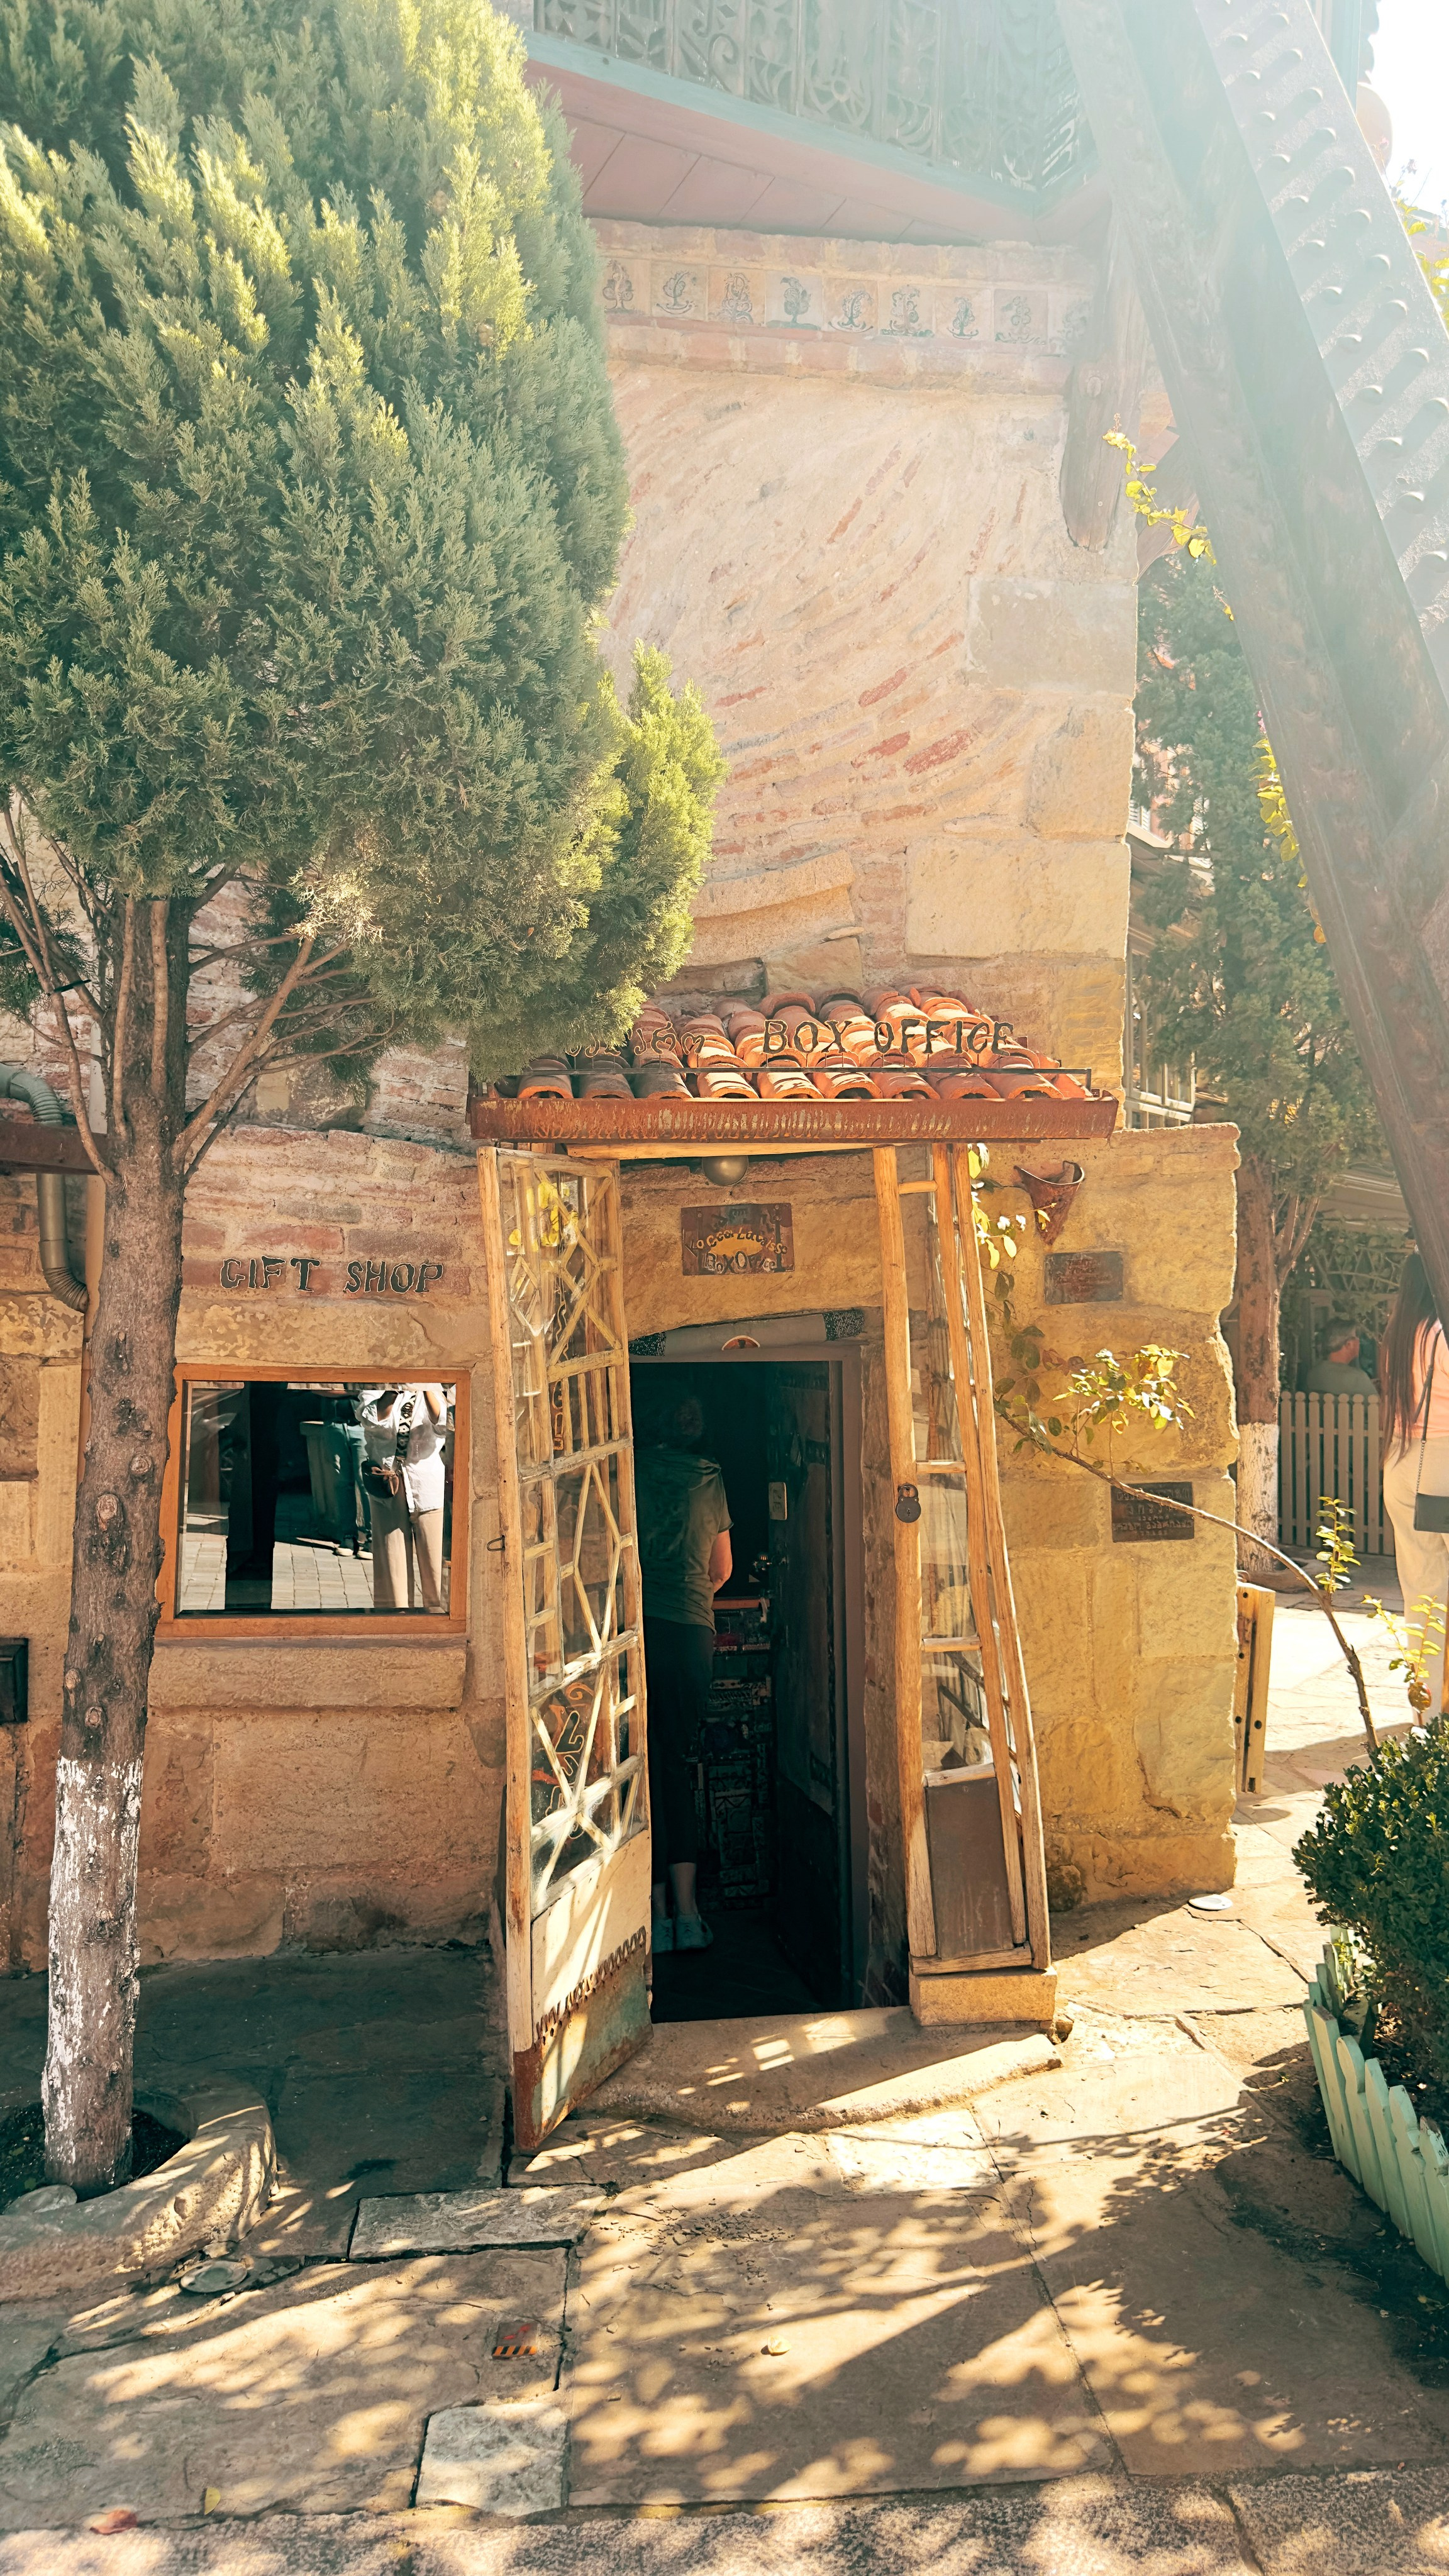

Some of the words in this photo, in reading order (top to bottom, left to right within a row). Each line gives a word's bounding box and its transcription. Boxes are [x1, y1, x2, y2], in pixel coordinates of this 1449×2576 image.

[762, 1018, 852, 1054] BOX
[874, 1018, 1014, 1056] OFFICE
[219, 1255, 321, 1292] GIFT
[343, 1258, 444, 1294] SHOP
